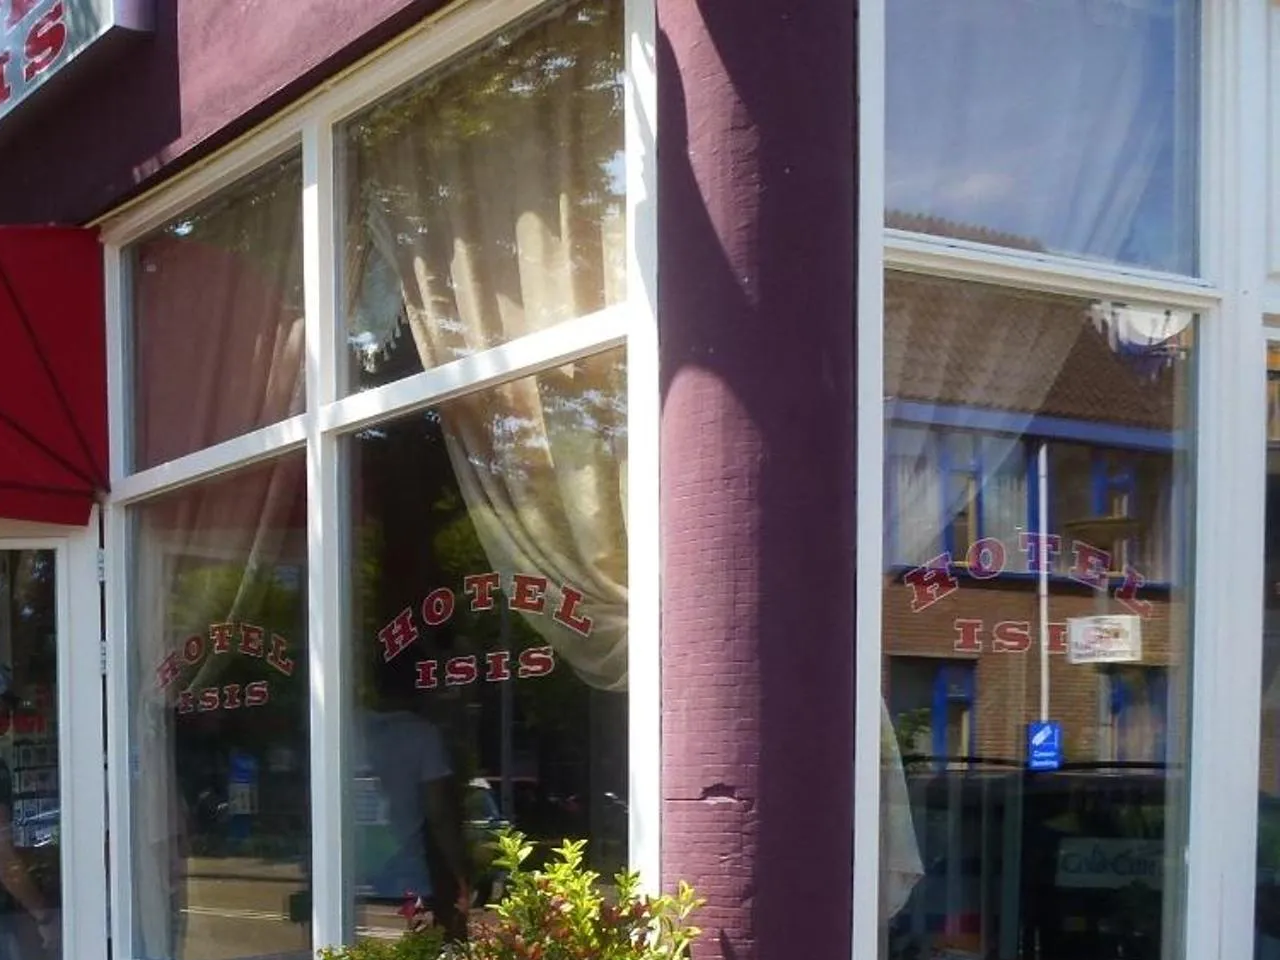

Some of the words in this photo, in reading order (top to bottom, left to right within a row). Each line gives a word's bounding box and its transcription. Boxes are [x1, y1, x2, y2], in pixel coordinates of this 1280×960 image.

[904, 532, 1154, 620] HOTEL
[376, 572, 594, 663] HOTEL
[155, 622, 294, 690] HOTEL
[414, 645, 555, 689] ISIS
[177, 680, 270, 714] ISIS
